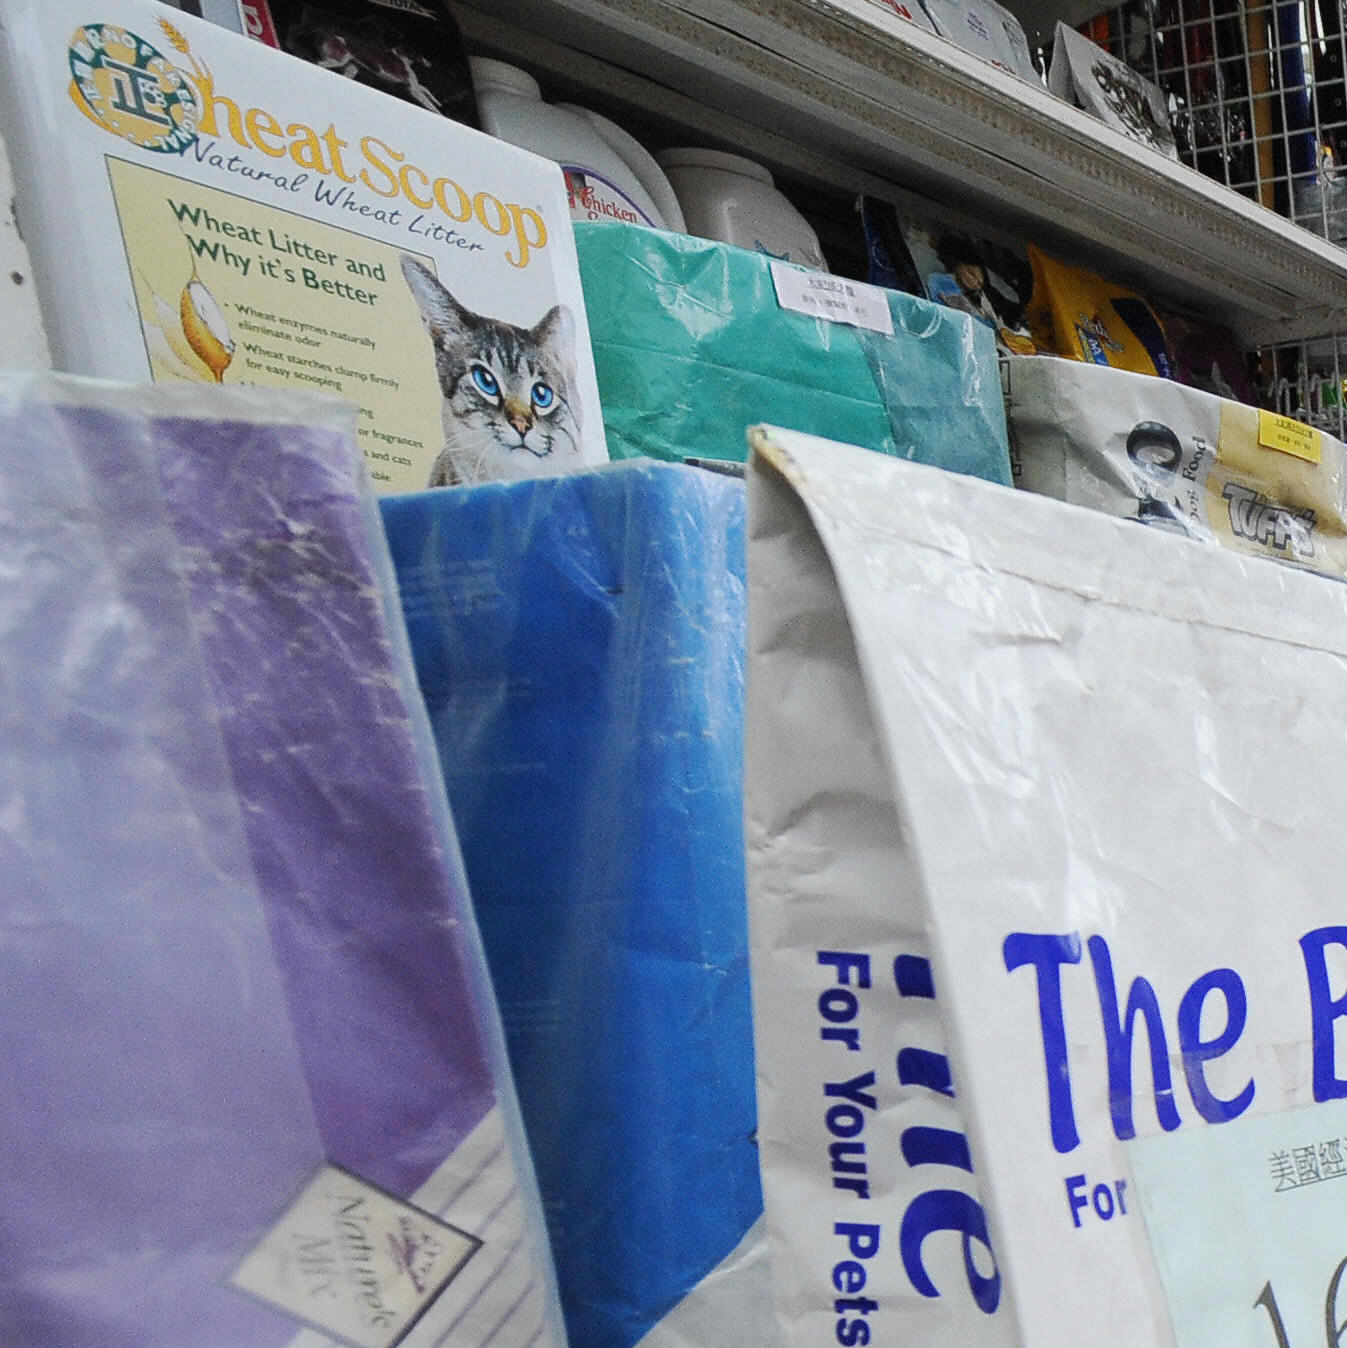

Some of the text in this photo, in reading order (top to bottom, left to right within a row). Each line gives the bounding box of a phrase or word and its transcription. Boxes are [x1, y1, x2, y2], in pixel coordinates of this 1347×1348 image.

[180, 138, 485, 254] Natural Wheat Litter
[358, 135, 549, 270] Scoop
[580, 184, 639, 226] Chicken
[166, 198, 387, 283] Wheat Litter and
[185, 234, 379, 307] Why it's Better
[235, 302, 377, 350] Wheat enzymes naturally
[238, 320, 322, 349] eliminate odor
[243, 342, 400, 391] Wheat starches clump firmly
[246, 357, 343, 392] for easy scooping
[1182, 436, 1208, 482] Food
[813, 949, 872, 1053] For
[1001, 929, 1258, 1155] The
[818, 1070, 877, 1201] Your
[1064, 1172, 1129, 1230] For
